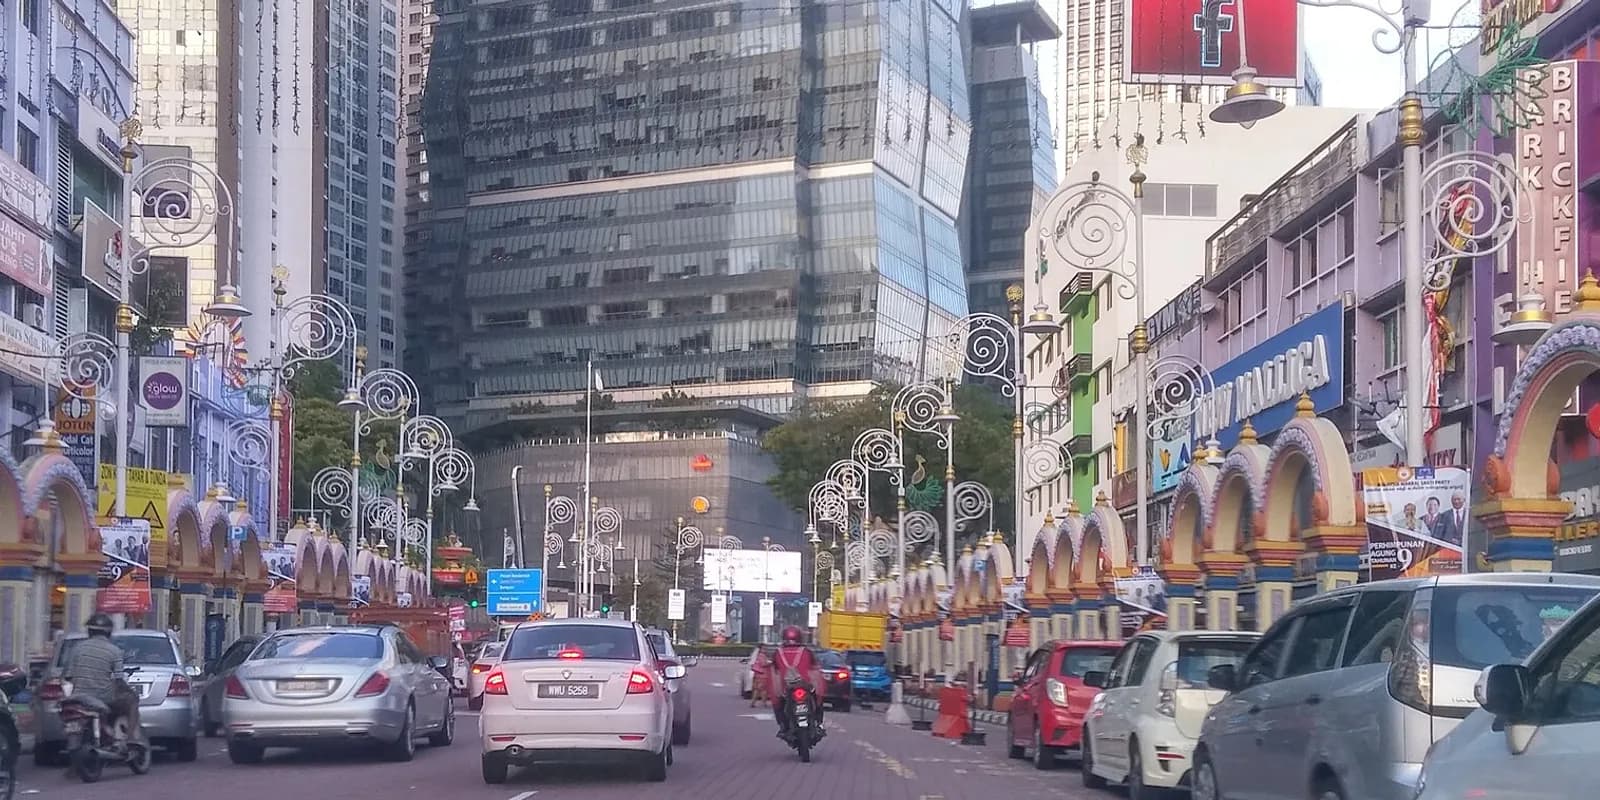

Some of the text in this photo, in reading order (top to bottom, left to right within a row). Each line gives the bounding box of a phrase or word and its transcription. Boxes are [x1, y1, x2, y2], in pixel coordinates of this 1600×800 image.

[1522, 70, 1544, 191] PARK
[1552, 66, 1574, 315] BRICKFIE
[153, 383, 178, 395] glow
[57, 421, 95, 430] JOTUN
[231, 526, 244, 540] P
[1397, 548, 1412, 572] 9
[568, 685, 588, 695] 5258
